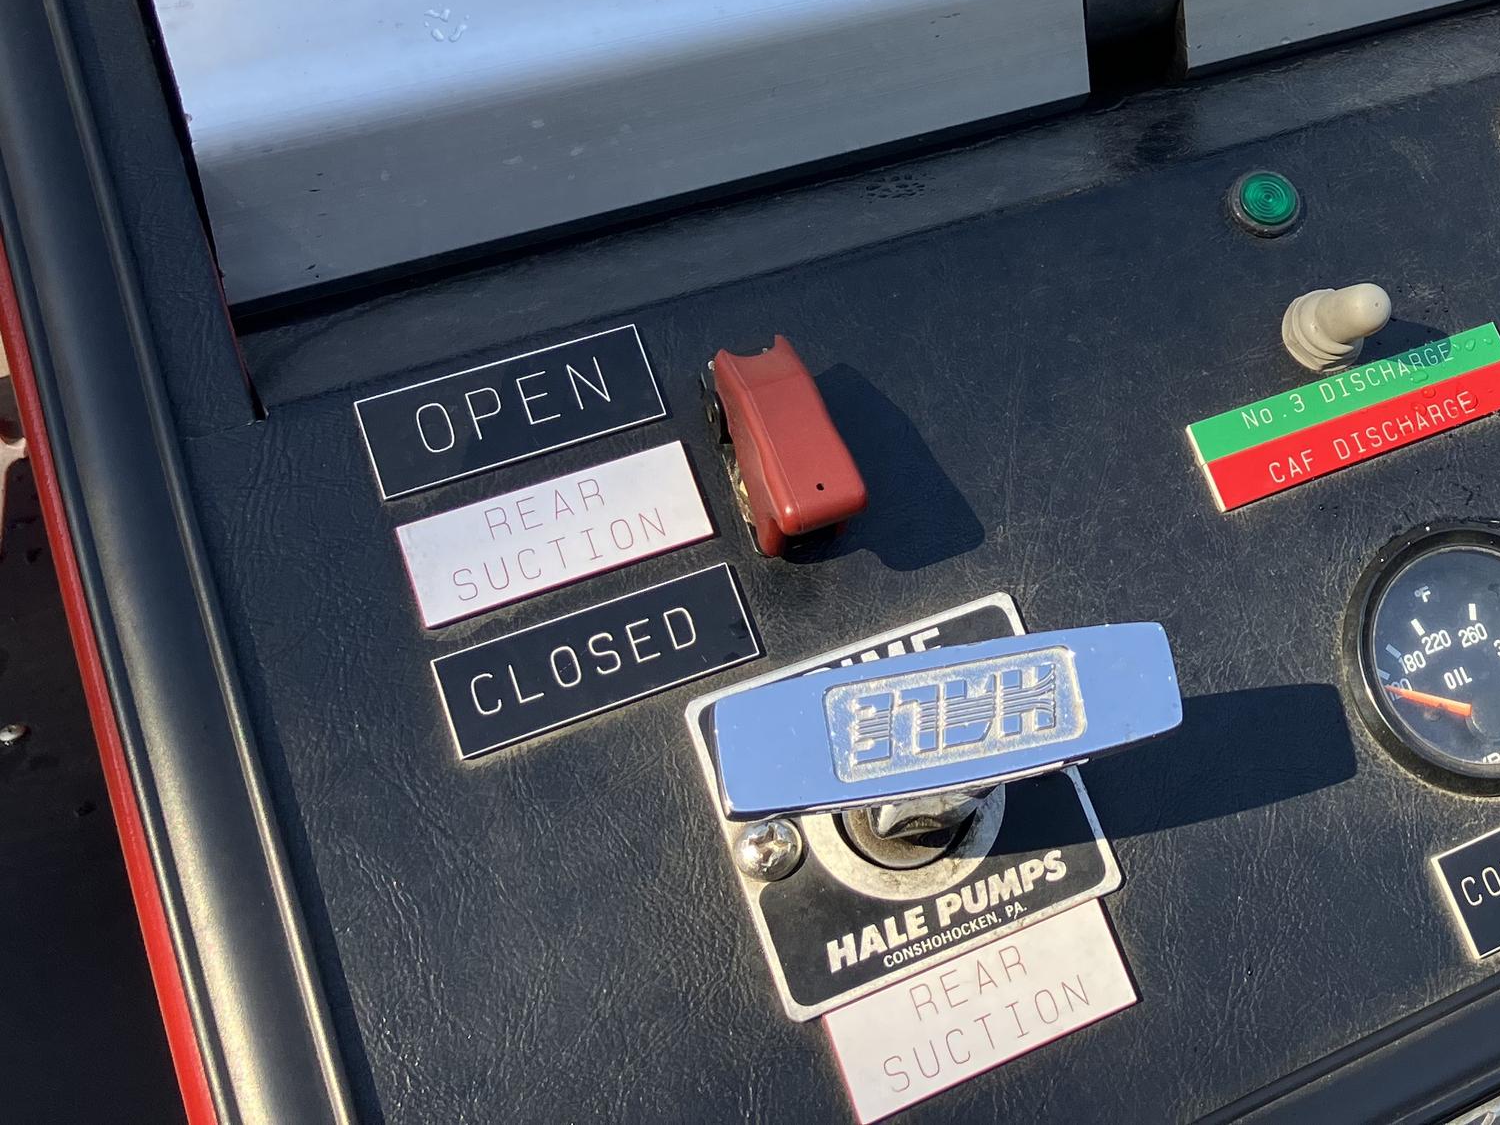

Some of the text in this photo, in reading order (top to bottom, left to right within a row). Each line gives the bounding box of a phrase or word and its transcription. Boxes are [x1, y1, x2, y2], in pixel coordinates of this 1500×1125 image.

[415, 356, 611, 453] OPEN
[1318, 342, 1455, 403] DISCHARGE
[1268, 391, 1476, 483] CAF DISCHARGE
[484, 478, 606, 540] REAR
[452, 507, 667, 601] SUCTION
[470, 607, 697, 715] CLOSED
[1400, 650, 1427, 674] 180
[1421, 629, 1452, 655] 220
[1458, 623, 1488, 648] 260
[1443, 666, 1473, 690] OIL
[826, 849, 1068, 975] HALE PUMPS
[883, 911, 1002, 968] CONSHOHOCKEN,
[909, 945, 1028, 1021] REAR
[883, 974, 1091, 1093] SUCTION
